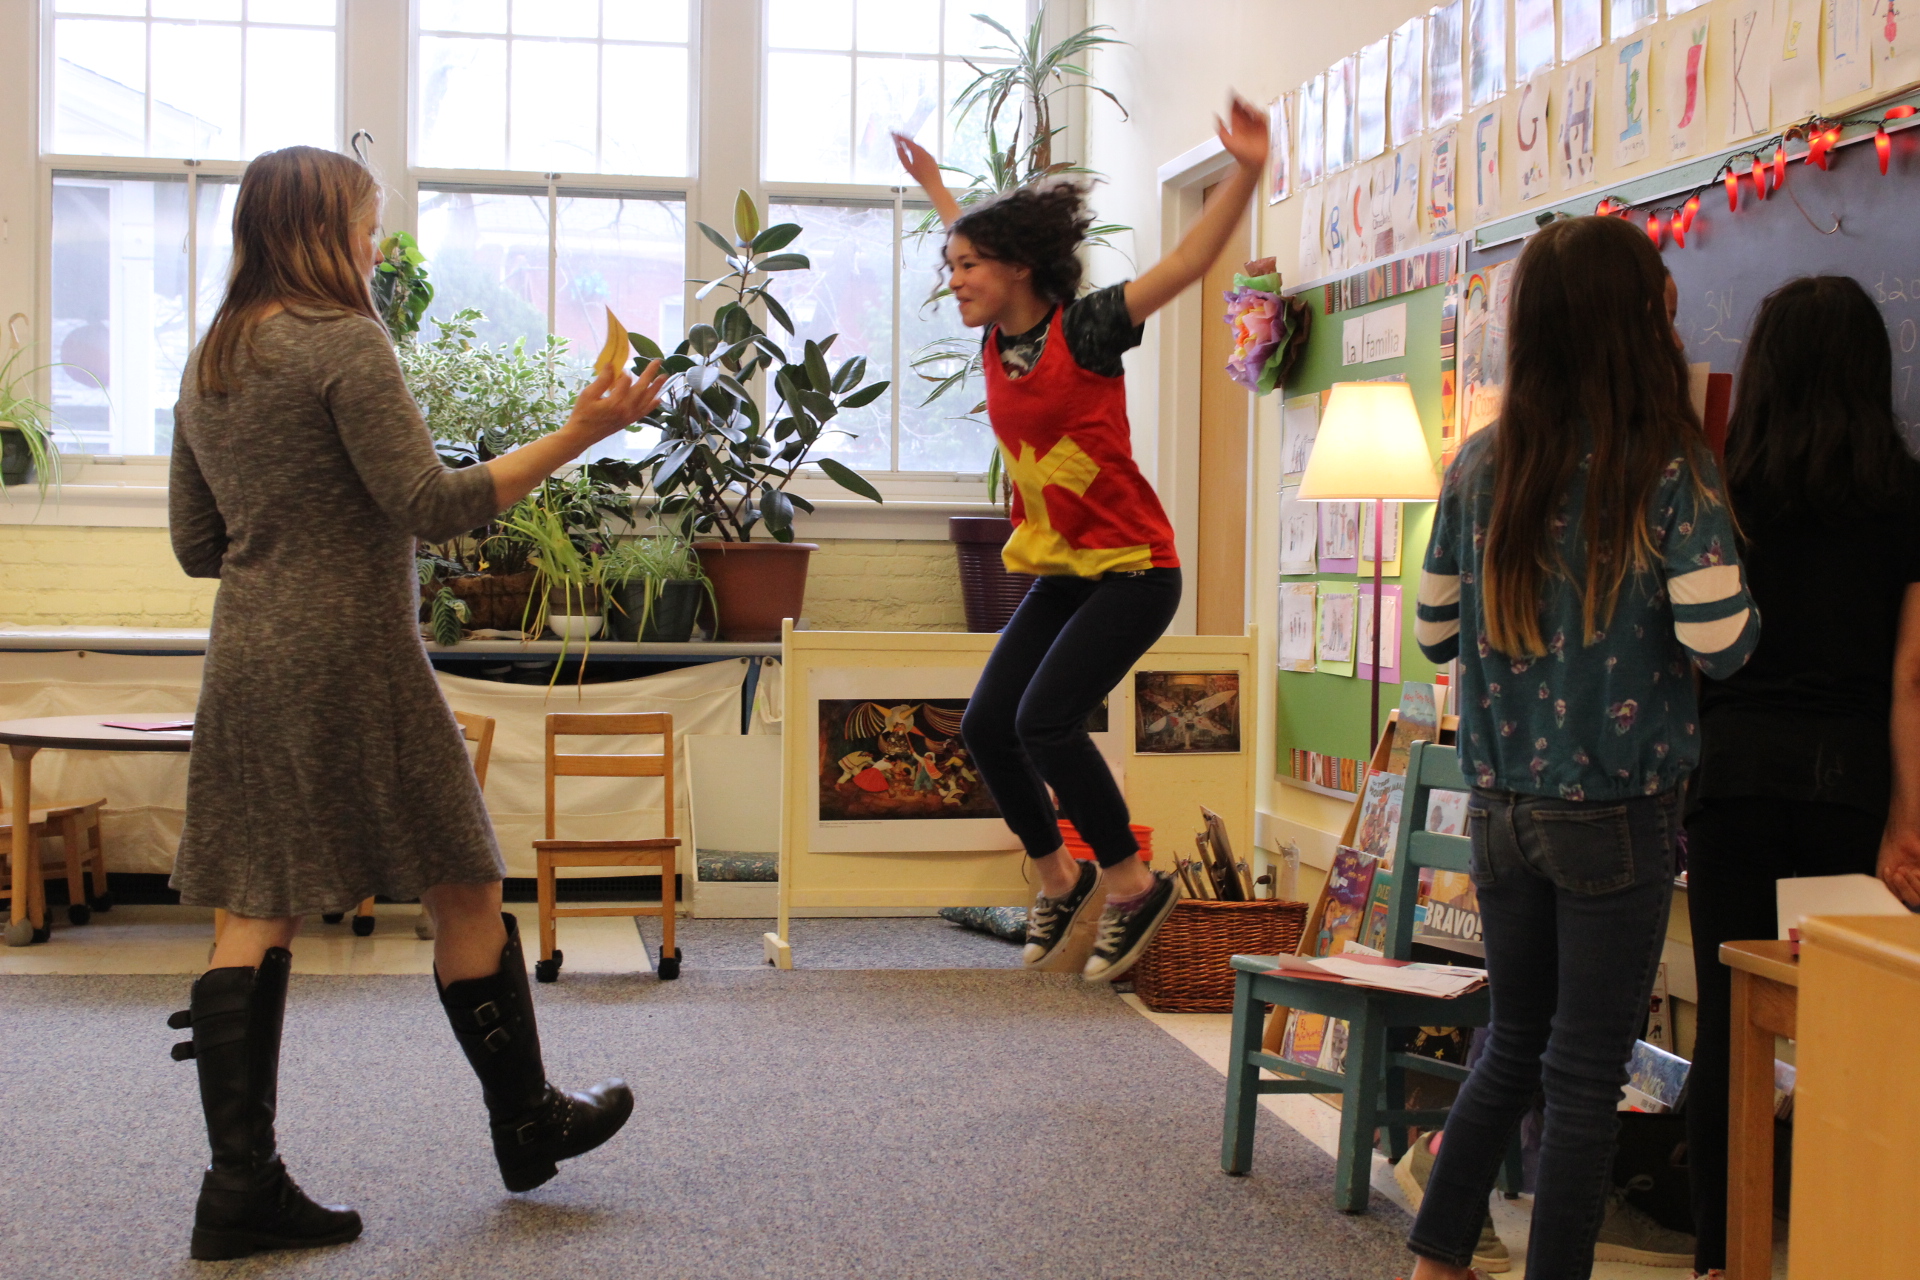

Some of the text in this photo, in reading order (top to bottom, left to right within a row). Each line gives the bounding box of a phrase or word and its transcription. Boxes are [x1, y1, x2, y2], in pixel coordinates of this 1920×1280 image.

[1619, 39, 1643, 142] I
[1677, 25, 1707, 129] J
[1732, 11, 1757, 134] K
[1517, 83, 1539, 152] G
[1563, 80, 1592, 161] H
[1476, 112, 1494, 206] F
[1330, 205, 1341, 249] B
[1353, 185, 1363, 238] C
[1346, 328, 1400, 365] La familia
[1424, 900, 1483, 942] BRAVO!
